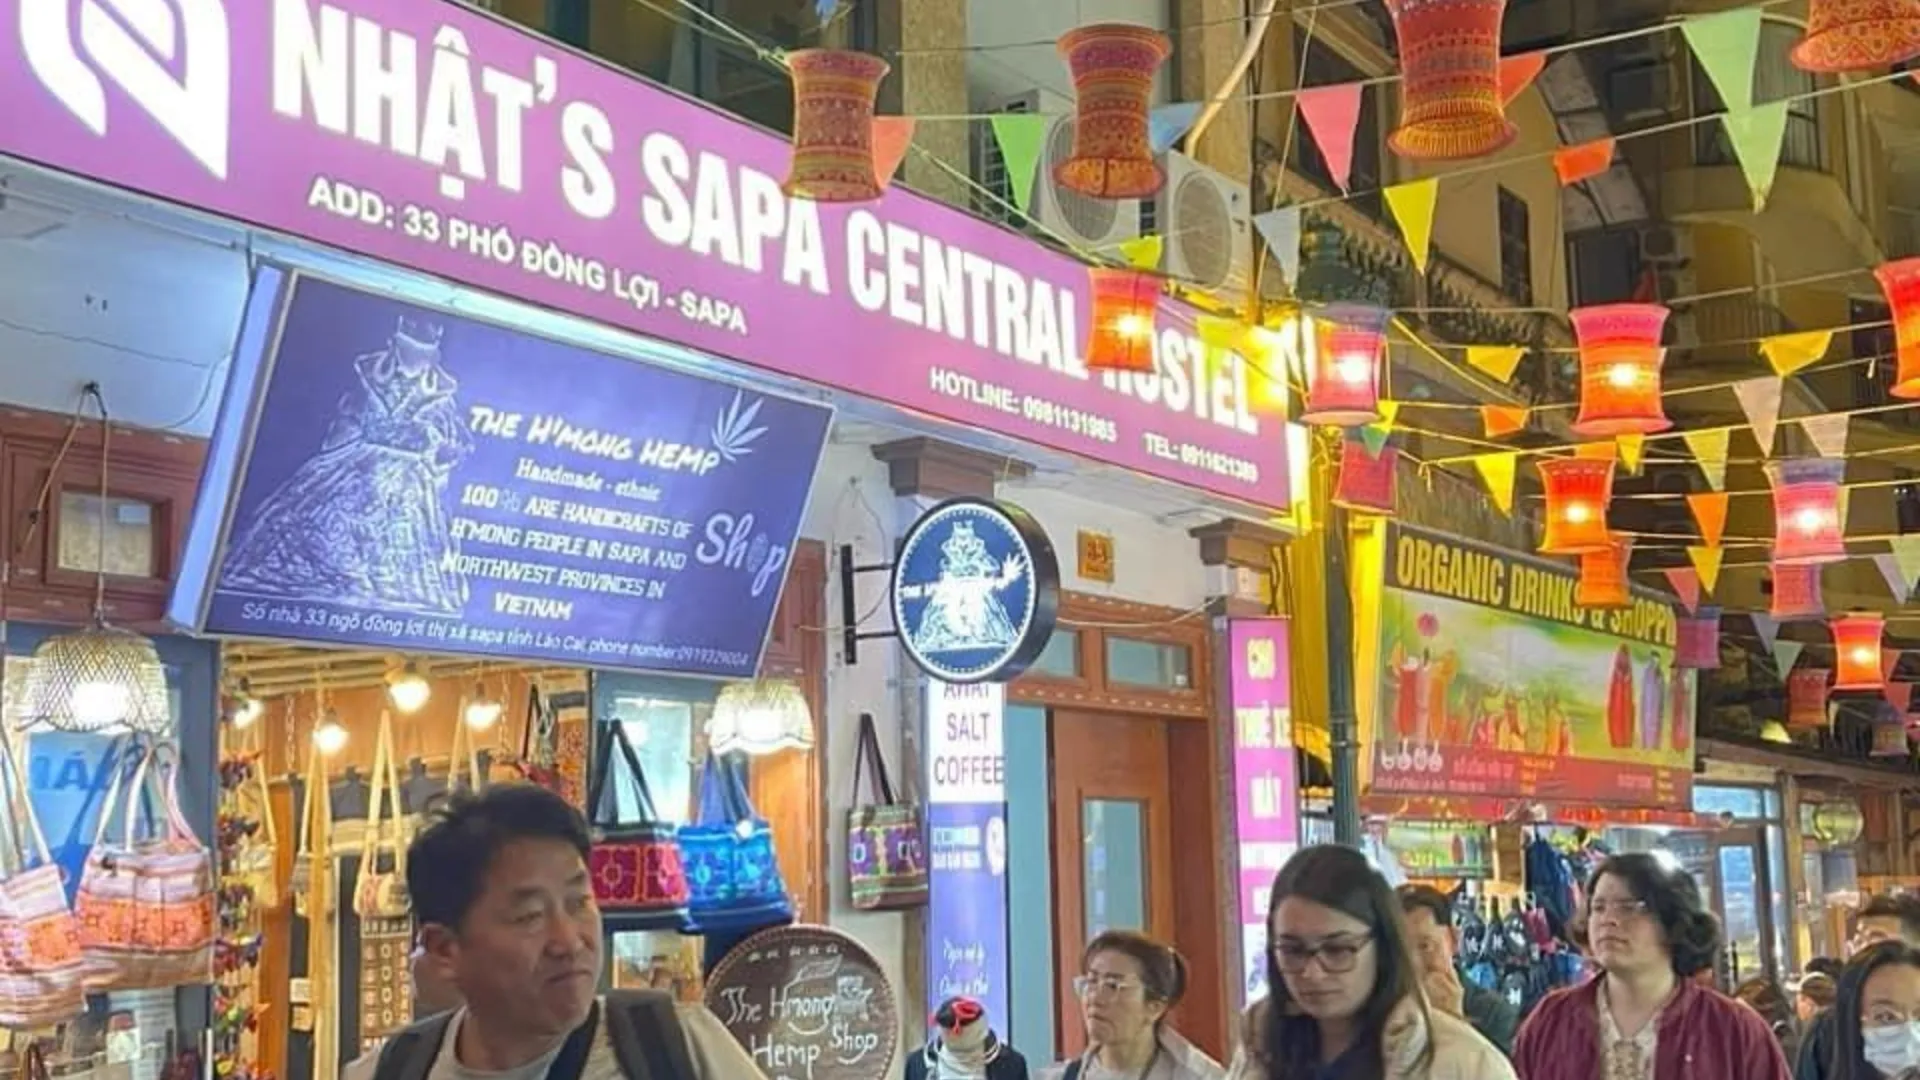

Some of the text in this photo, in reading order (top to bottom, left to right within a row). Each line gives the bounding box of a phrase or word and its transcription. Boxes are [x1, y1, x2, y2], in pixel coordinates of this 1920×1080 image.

[272, 4, 1259, 435] NHẬT'S SAPA CENTRAL OSTEL
[308, 177, 394, 228] ADD:
[404, 205, 441, 242] 33
[681, 291, 748, 335] SAPA
[930, 366, 1020, 415] HOTLINE:
[469, 406, 722, 477] THE H'MONG HEMP
[1143, 433, 1178, 461] TEL:
[516, 457, 605, 492] Handmade
[614, 480, 663, 502] ethnic
[524, 495, 560, 519] ARE
[562, 501, 670, 537] HANDICRAFTS
[672, 520, 695, 540] OF
[522, 529, 585, 558] PEOPLE
[587, 540, 603, 559] IN
[604, 542, 651, 567] SAPA
[653, 551, 688, 571] AND
[1396, 535, 1505, 606] ORGANIC
[440, 552, 667, 600] NORTHWEST PROVINCES IN
[304, 607, 327, 627] 33
[493, 591, 573, 621] VIETNAM
[946, 711, 991, 742] SALT
[933, 755, 1006, 786] COFFEE
[720, 984, 837, 1036] The Hmong
[751, 1022, 879, 1080] Hemp Shop
